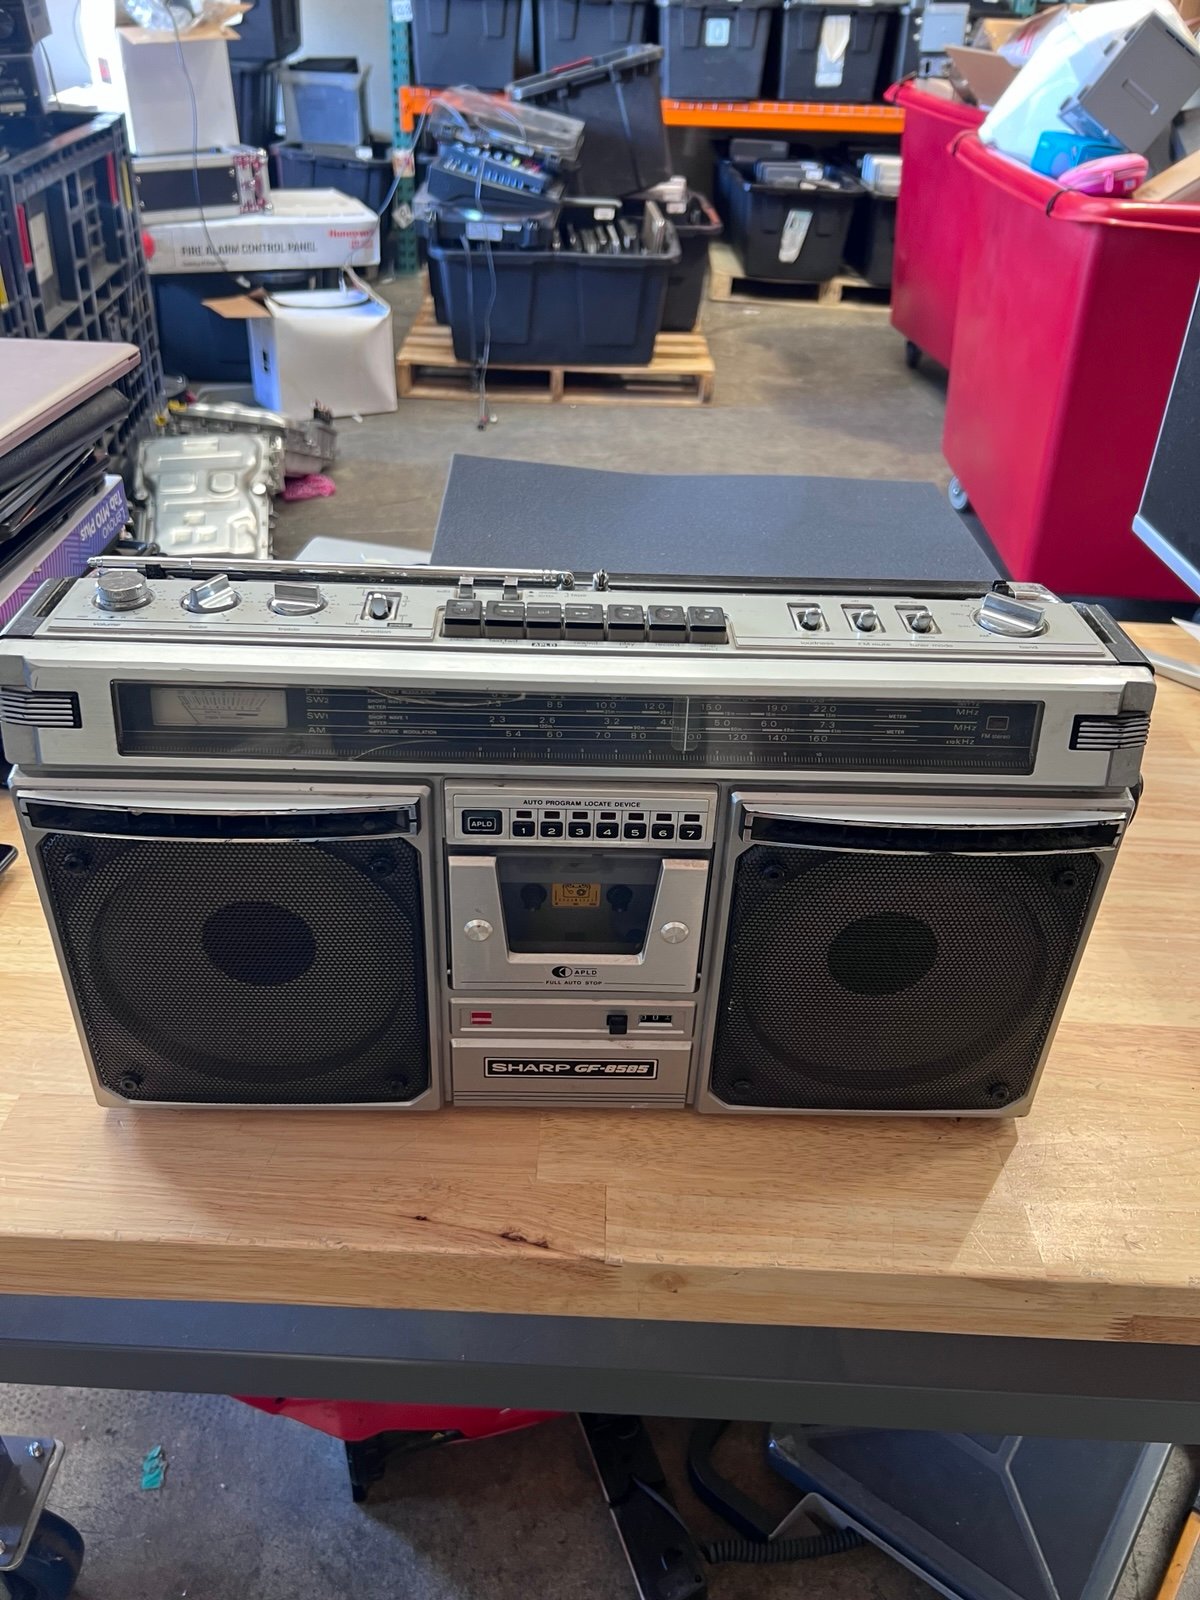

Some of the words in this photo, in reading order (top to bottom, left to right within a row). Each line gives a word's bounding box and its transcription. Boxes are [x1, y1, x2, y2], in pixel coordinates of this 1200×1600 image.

[109, 490, 123, 511] Tab
[95, 503, 111, 528] M10
[80, 517, 97, 541] Plus
[545, 799, 582, 807] PROGRAM
[471, 820, 493, 828] APLD
[575, 828, 584, 836] 3
[631, 829, 640, 837] 5
[686, 830, 695, 838] 7
[491, 1063, 571, 1073] SHARP
[574, 1064, 650, 1074] GF-8585
